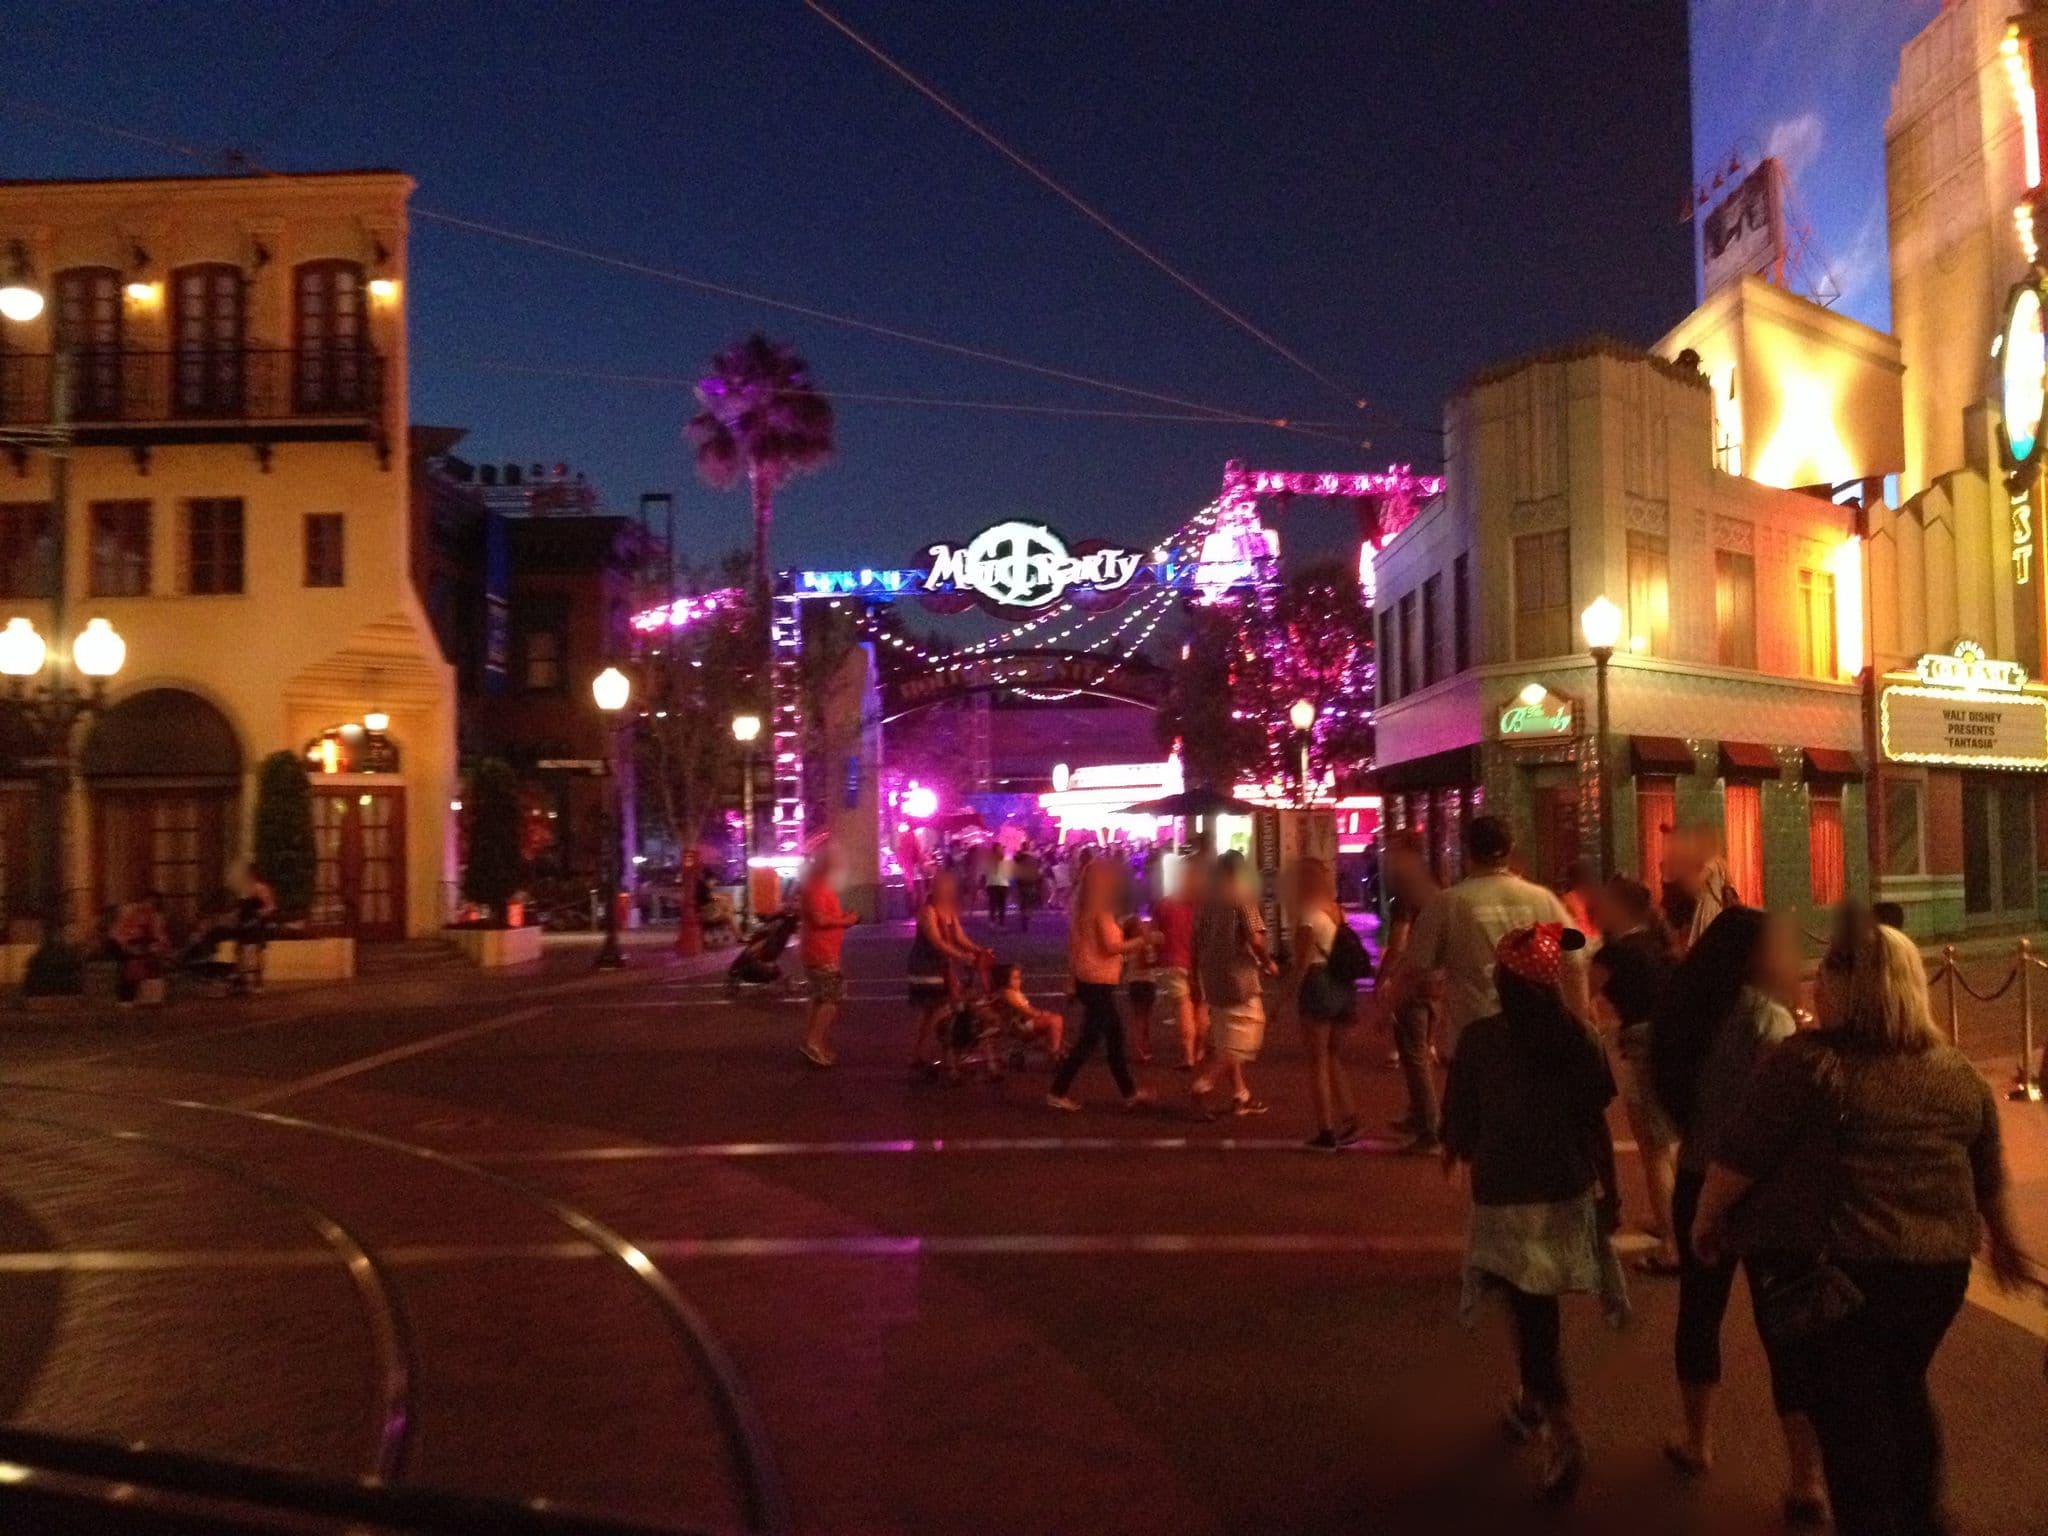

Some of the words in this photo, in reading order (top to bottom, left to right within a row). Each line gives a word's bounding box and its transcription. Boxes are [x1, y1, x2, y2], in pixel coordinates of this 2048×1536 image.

[1943, 709, 1966, 721] WALT
[1968, 711, 2002, 723] DISNEY
[1948, 723, 1995, 736] PRESENTS
